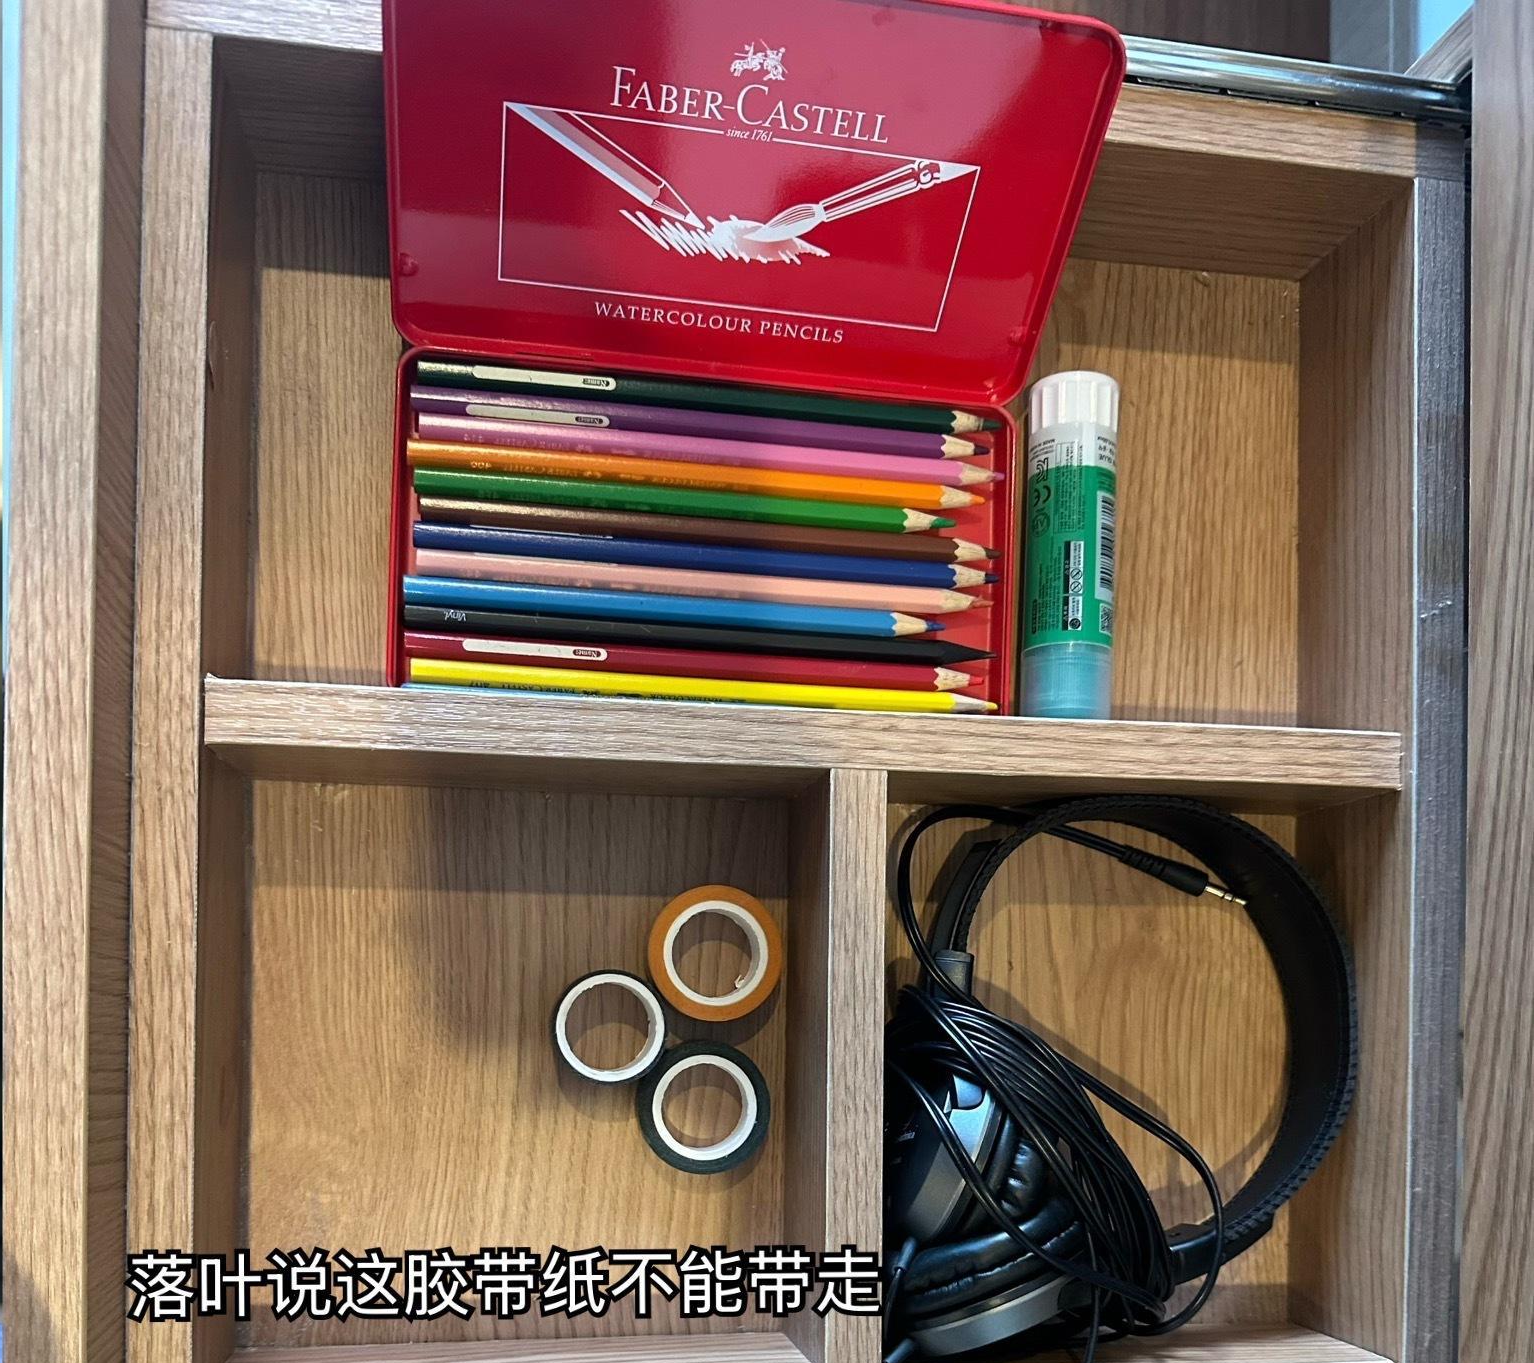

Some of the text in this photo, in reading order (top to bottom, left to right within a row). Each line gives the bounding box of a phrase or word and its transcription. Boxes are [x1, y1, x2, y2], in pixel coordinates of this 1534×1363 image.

[609, 64, 890, 145] FABER-CASTELL
[725, 125, 773, 143] since 1761
[593, 300, 845, 344] WATERCOLOUR PENCILS
